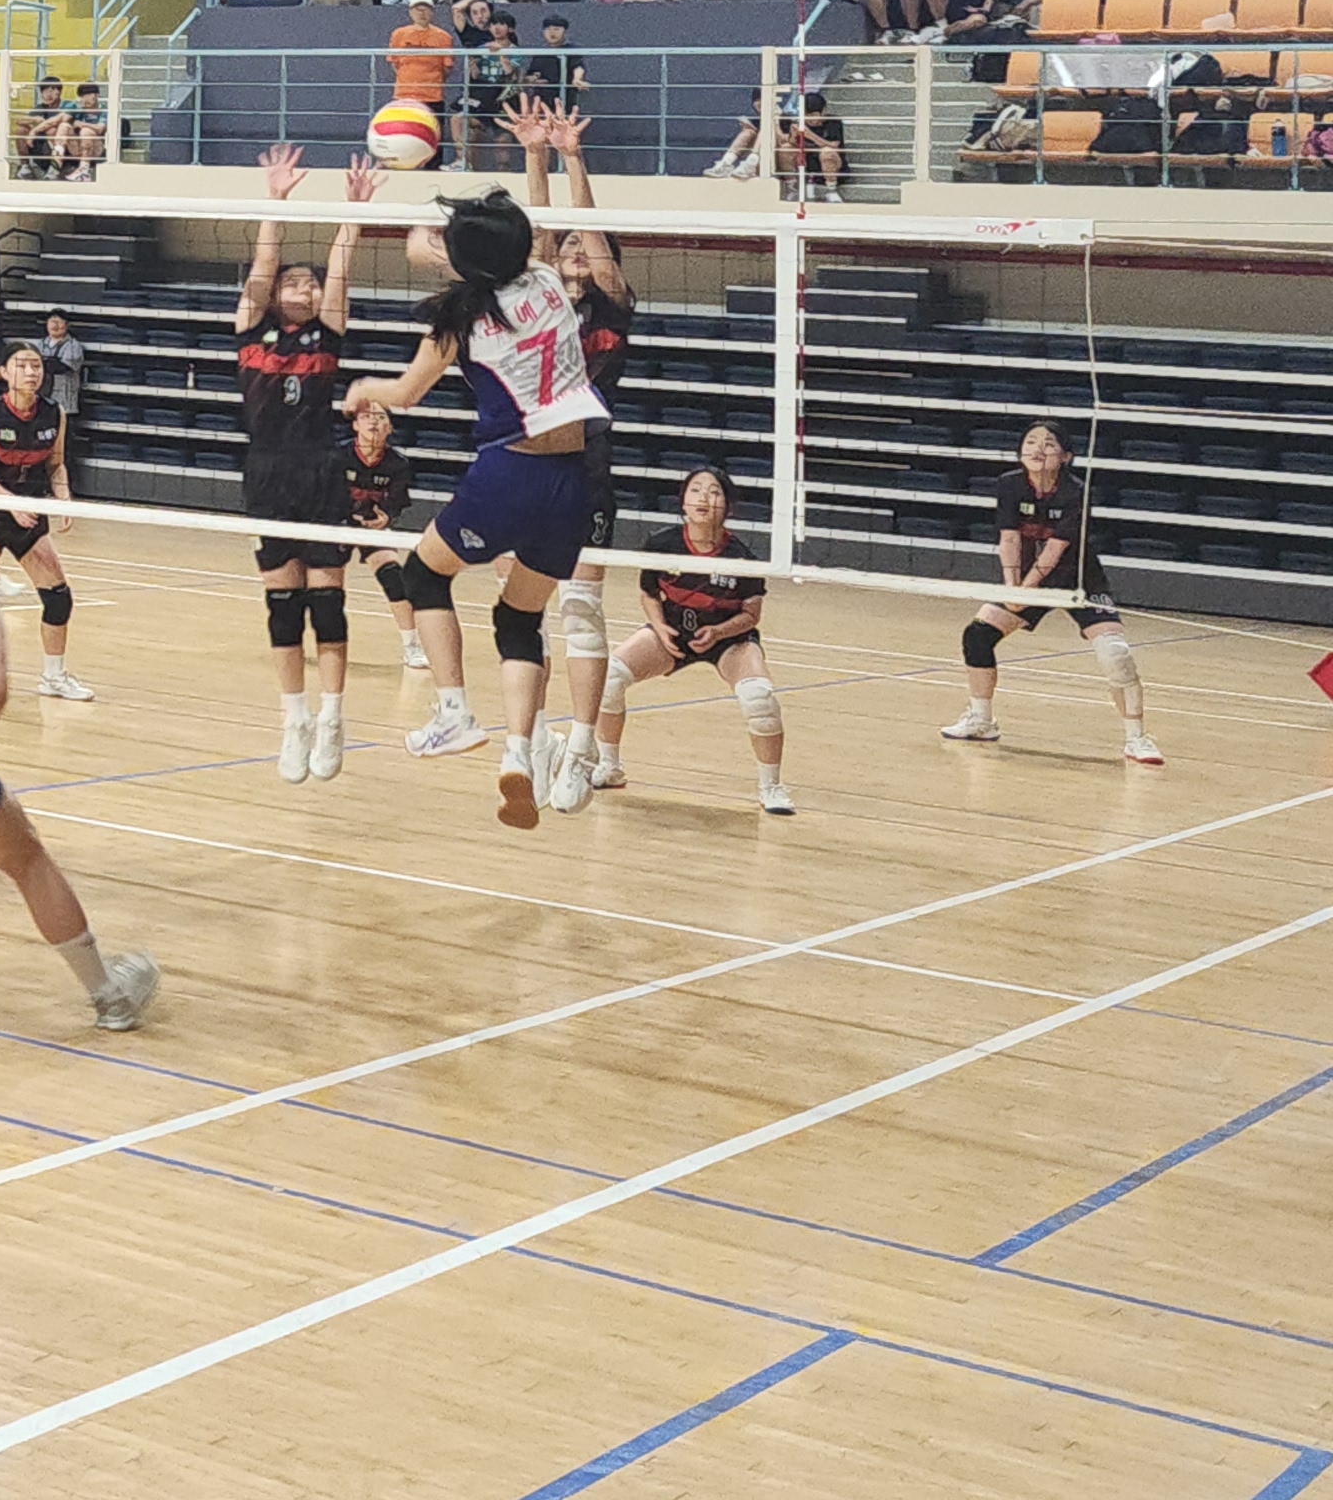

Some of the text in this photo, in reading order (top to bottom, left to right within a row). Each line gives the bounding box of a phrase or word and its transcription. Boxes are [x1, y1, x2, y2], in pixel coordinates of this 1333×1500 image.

[515, 327, 558, 406] 7
[283, 375, 302, 405] 9
[682, 608, 697, 631] 8
